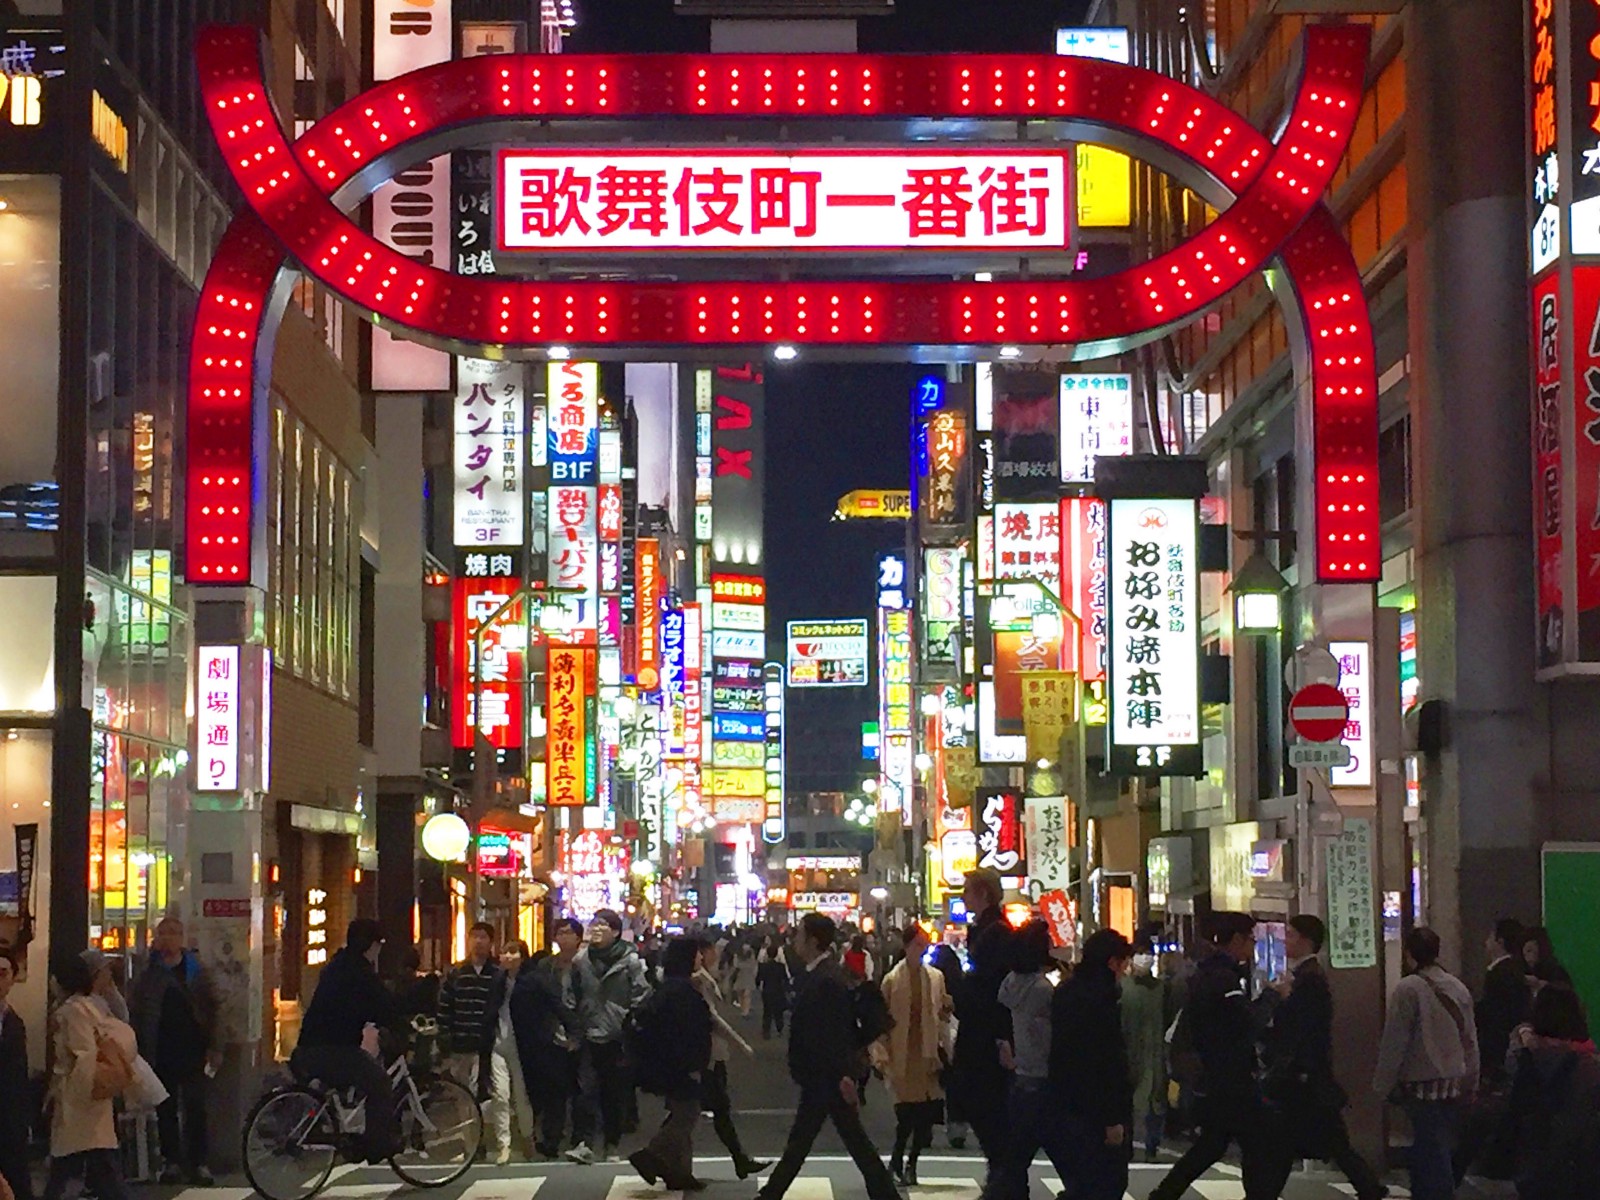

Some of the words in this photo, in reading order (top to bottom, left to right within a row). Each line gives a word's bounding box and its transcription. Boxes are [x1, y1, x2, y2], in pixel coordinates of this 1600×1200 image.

[520, 165, 1049, 238] 歌舞伎町一番街
[1541, 217, 1556, 256] 8F
[462, 383, 496, 500] バンタイ
[502, 383, 516, 492] タイ国料理専門店
[552, 461, 593, 479] B1F
[461, 517, 516, 525] RESTAURANT
[475, 528, 501, 541] 3F
[465, 553, 512, 576] 焼肉
[1125, 540, 1163, 730] お好み焼本陣
[208, 657, 230, 778] 劇場通り
[1136, 746, 1171, 767] 2F
